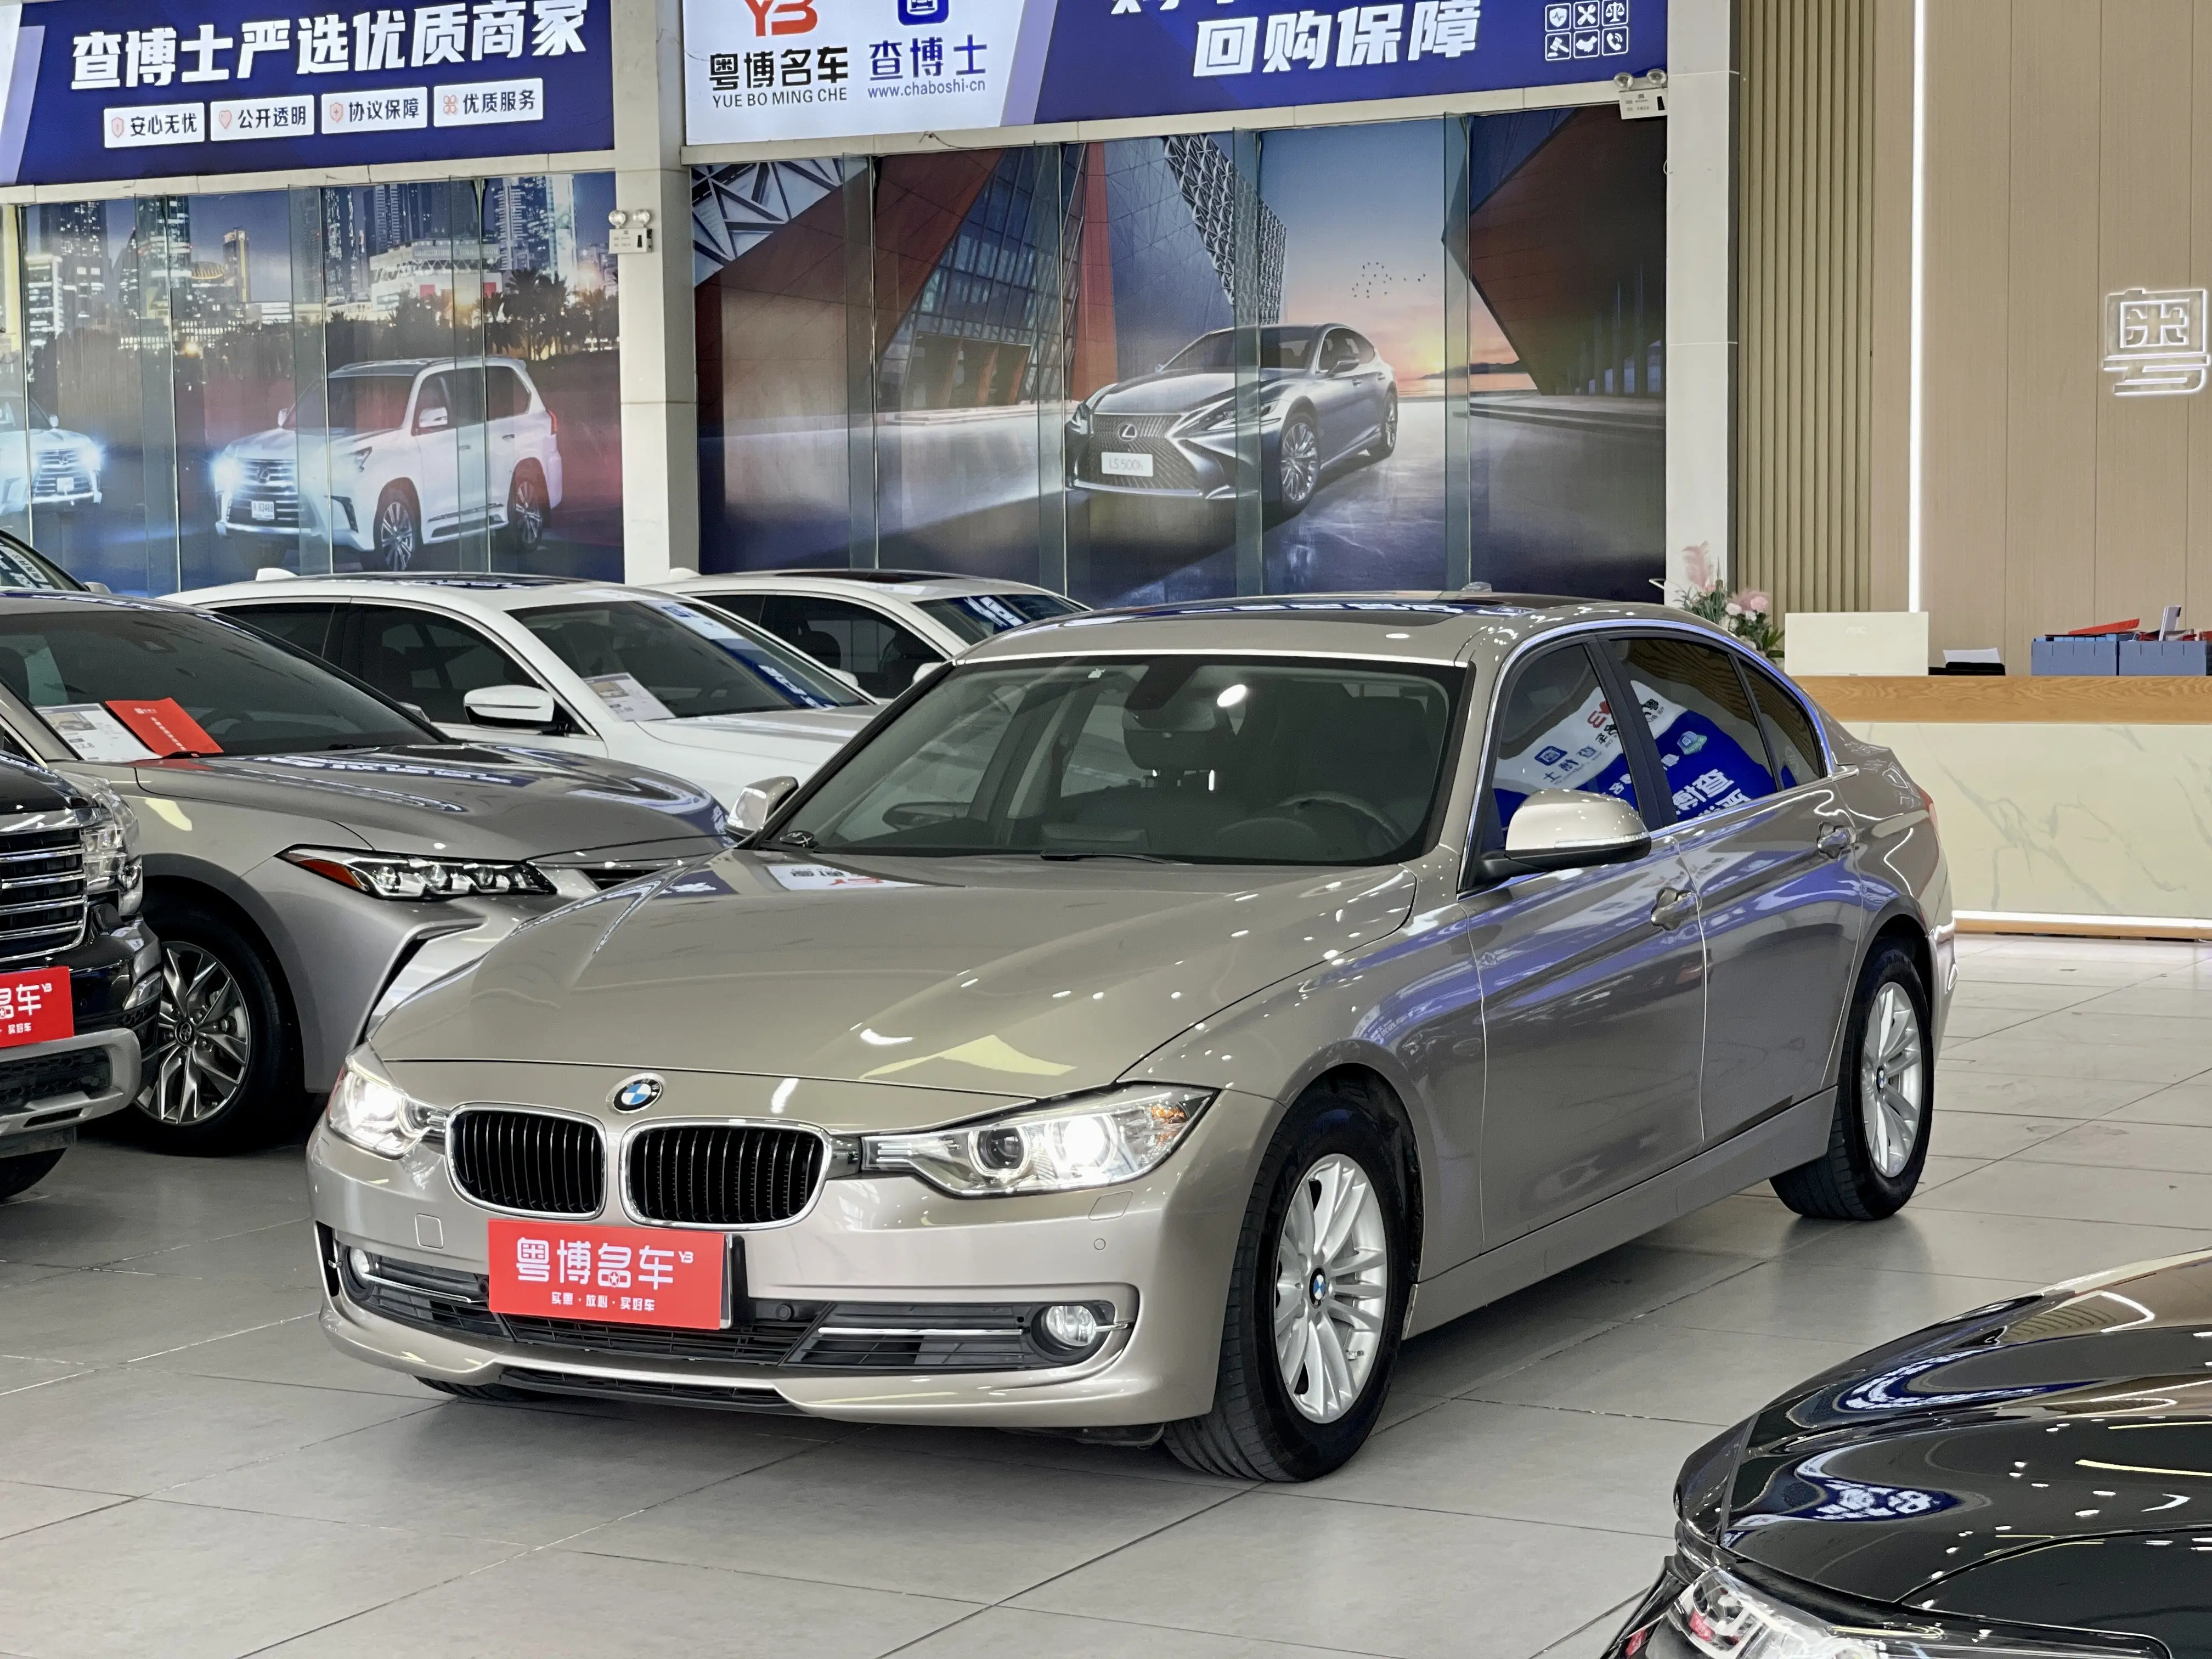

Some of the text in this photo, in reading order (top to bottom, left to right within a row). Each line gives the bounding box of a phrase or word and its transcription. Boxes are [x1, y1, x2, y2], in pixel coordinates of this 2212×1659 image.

[72, 0, 588, 91] 查博士严选优质商家
[869, 34, 987, 81] 查博士
[1193, 0, 1481, 77] 回购保障
[709, 47, 848, 91] 粤博名车
[238, 106, 307, 129] 公开透明
[348, 98, 420, 122] 协议保障
[462, 90, 535, 115] 优质服务
[713, 87, 847, 108] YUE BO MING CHE
[131, 112, 198, 137] 安心无忧
[2102, 287, 2211, 396] 粤
[516, 1237, 675, 1290] 粤博名车
